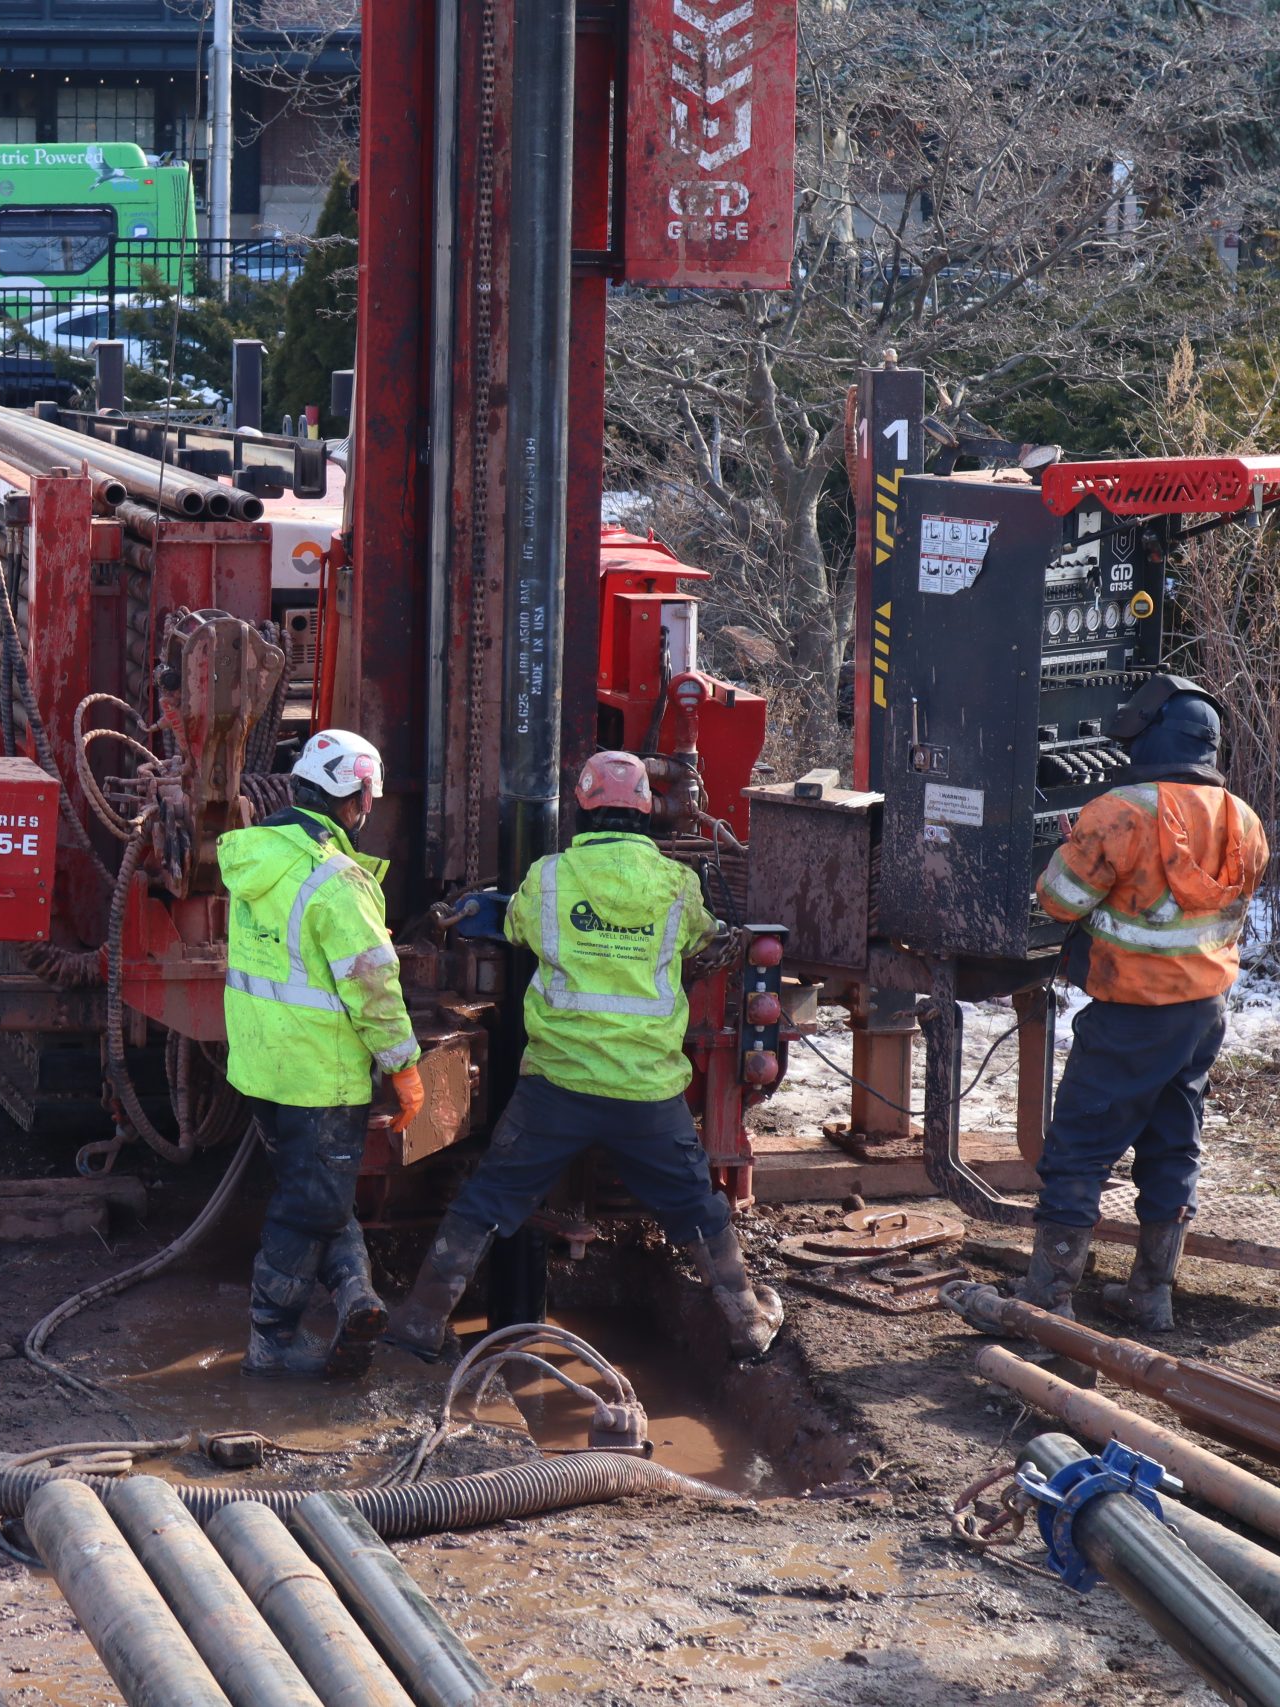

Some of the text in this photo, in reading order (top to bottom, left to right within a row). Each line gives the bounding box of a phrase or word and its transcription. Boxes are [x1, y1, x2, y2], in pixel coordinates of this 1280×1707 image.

[34, 147, 103, 165] Powered
[882, 419, 908, 460] 1
[1111, 563, 1134, 581] GTD
[1109, 581, 1133, 591] GT35-E
[532, 606, 545, 630] USA
[531, 662, 544, 696] MADE
[599, 932, 650, 943] WELL DRILLING
